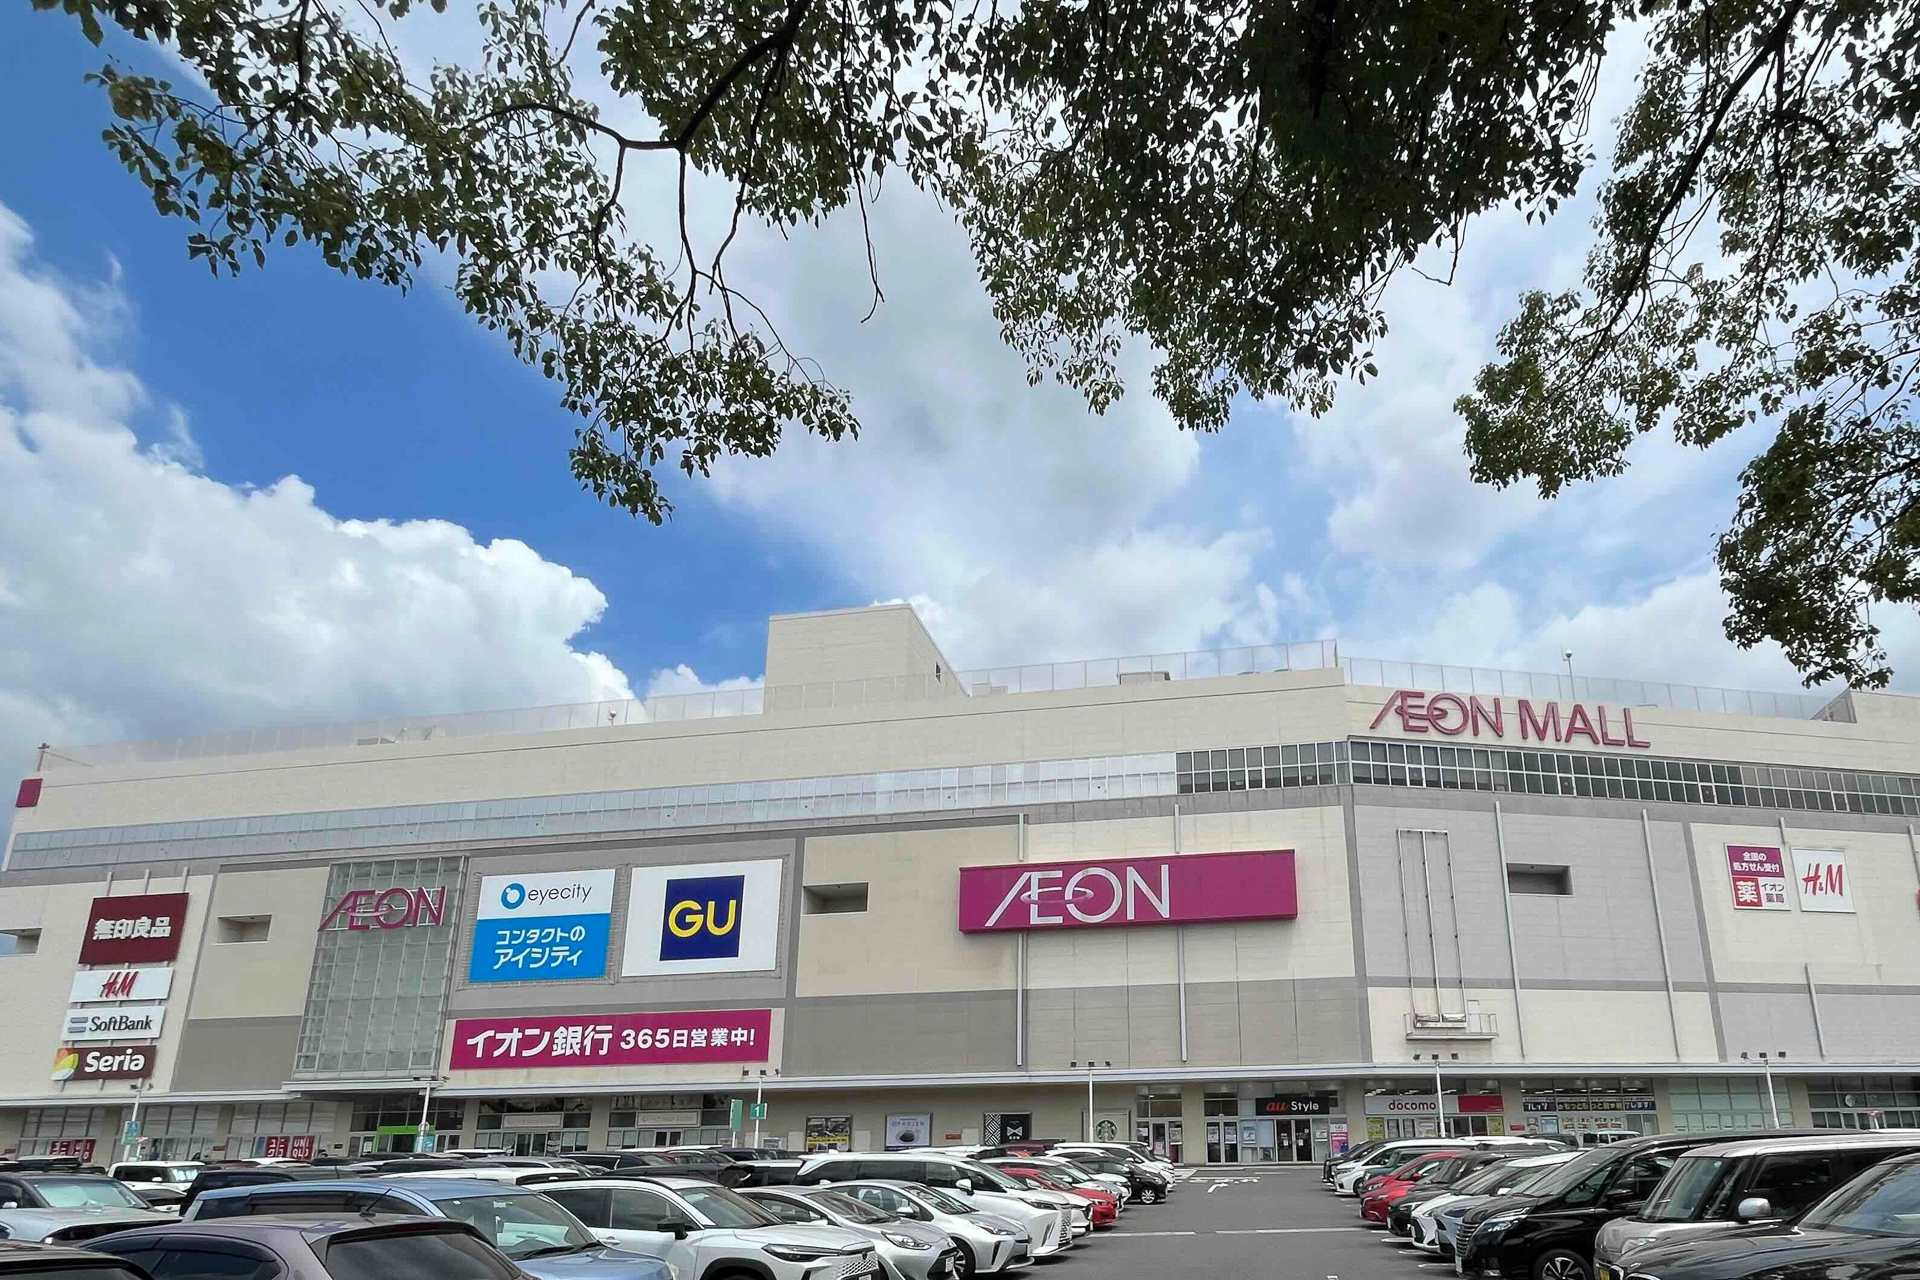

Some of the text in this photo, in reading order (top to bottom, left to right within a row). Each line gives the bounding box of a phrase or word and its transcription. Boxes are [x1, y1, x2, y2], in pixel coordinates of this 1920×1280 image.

[1517, 699, 1651, 748] MALL
[1743, 851, 1767, 861] 全国の
[1736, 880, 1758, 903] 薬
[1761, 883, 1785, 892] イオン
[1802, 863, 1844, 897] H&M
[527, 883, 592, 904] eyecity
[92, 916, 172, 941] 無印良品
[668, 899, 737, 938] GU
[496, 925, 586, 945] コンタクトの
[493, 946, 583, 970] アイシティ
[99, 971, 140, 999] H&M
[89, 1015, 153, 1032] SoftBank
[466, 1024, 756, 1059] イオン銀行 365日営業中!
[84, 1048, 145, 1073] Seria
[1265, 1100, 1320, 1112] au Style
[1388, 1099, 1437, 1111] docomo
